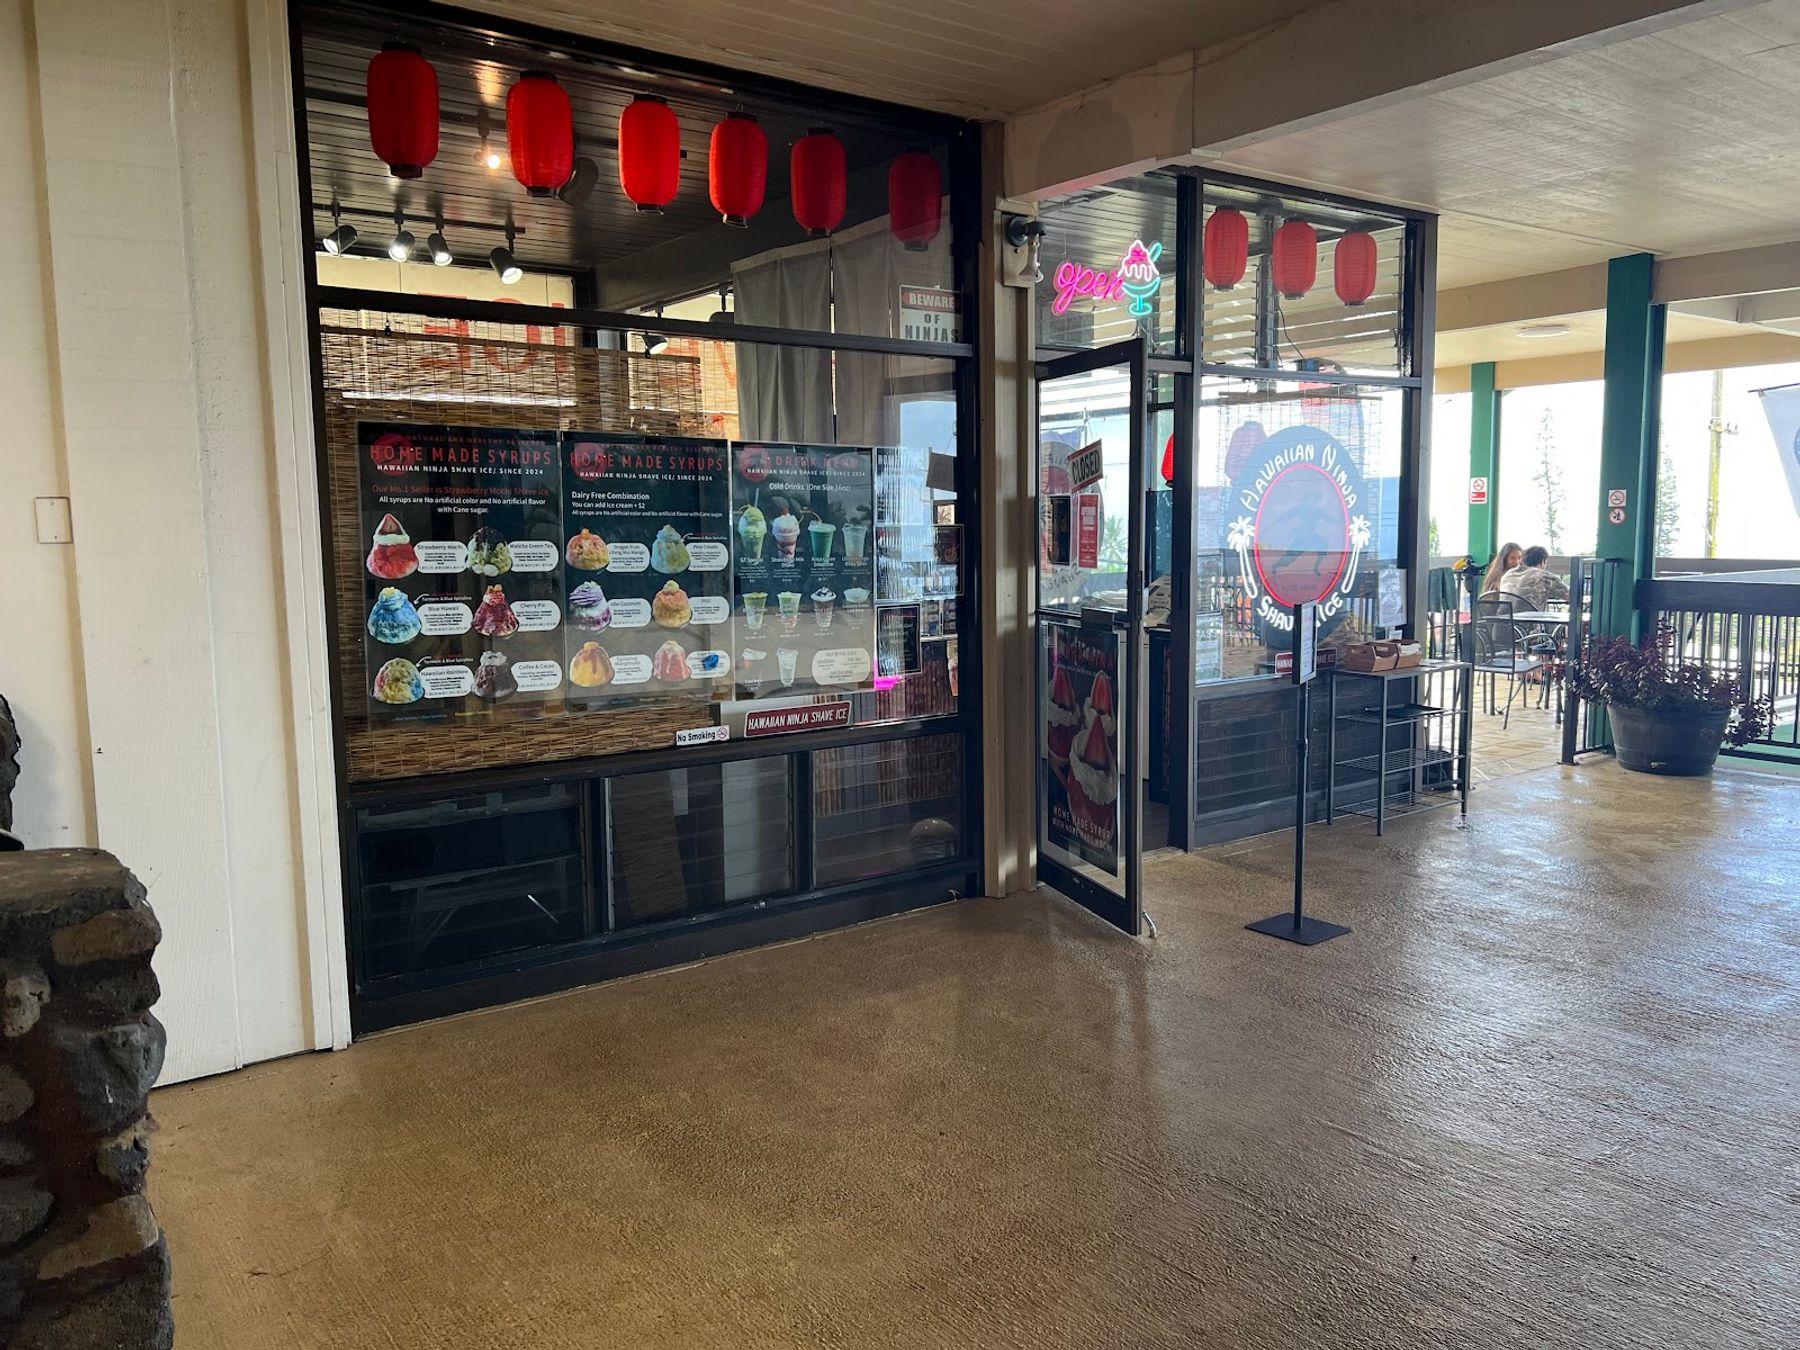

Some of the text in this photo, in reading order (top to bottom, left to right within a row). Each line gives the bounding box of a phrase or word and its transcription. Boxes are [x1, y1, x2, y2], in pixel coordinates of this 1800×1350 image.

[909, 293, 954, 309] BEWARE
[924, 313, 940, 324] OF
[905, 324, 959, 342] NINJAS
[370, 445, 551, 465] HOME MADE SYRUPS
[571, 452, 723, 471] HOME MADE SYRUPS
[376, 464, 420, 472] HAWAIIAN
[423, 465, 448, 473] NINJA
[451, 466, 477, 474] SHAVE
[499, 467, 522, 475] SINCE
[1072, 449, 1100, 484] CLOSED
[769, 482, 784, 490] Cold
[1240, 444, 1357, 513] HAWAIIAN NINJA
[389, 497, 412, 505] syrups
[434, 496, 462, 504] artificial
[502, 497, 528, 505] artificial
[528, 497, 546, 505] flavor
[571, 491, 650, 500] Dairy Free Combination
[1257, 595, 1310, 632] SHAV
[1317, 591, 1344, 623] ICE
[748, 708, 848, 731] HAWAIIAN NINJA SHAVE ICE
[677, 730, 716, 743] No Smoking
